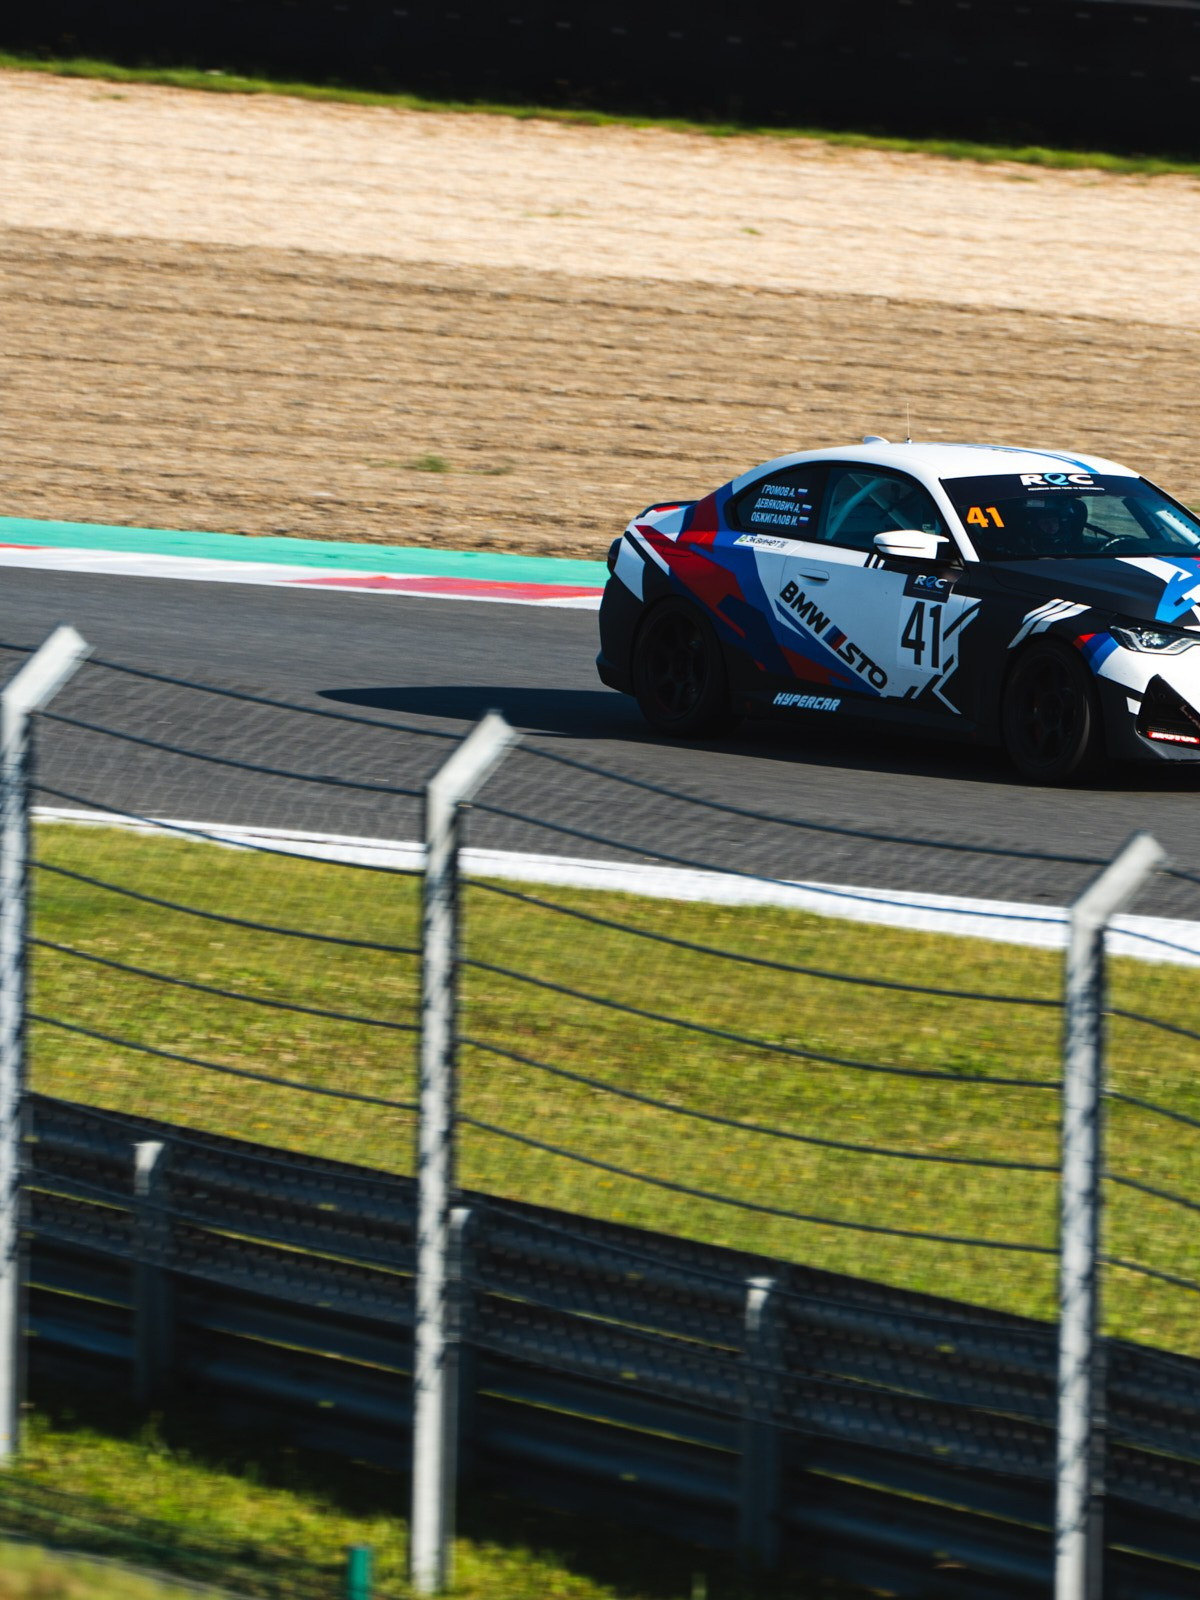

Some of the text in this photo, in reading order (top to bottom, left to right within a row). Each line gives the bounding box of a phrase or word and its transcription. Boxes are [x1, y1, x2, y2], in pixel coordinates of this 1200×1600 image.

[761, 484, 790, 497] ГРОМОВ
[754, 497, 796, 512] ДЕВЯКОВИЧ
[751, 511, 791, 525] ОБЖИГАЛОВ
[966, 506, 1005, 528] 41
[779, 580, 889, 690] BMW STO
[901, 600, 942, 669] 41
[773, 692, 841, 712] HYPERCAR
